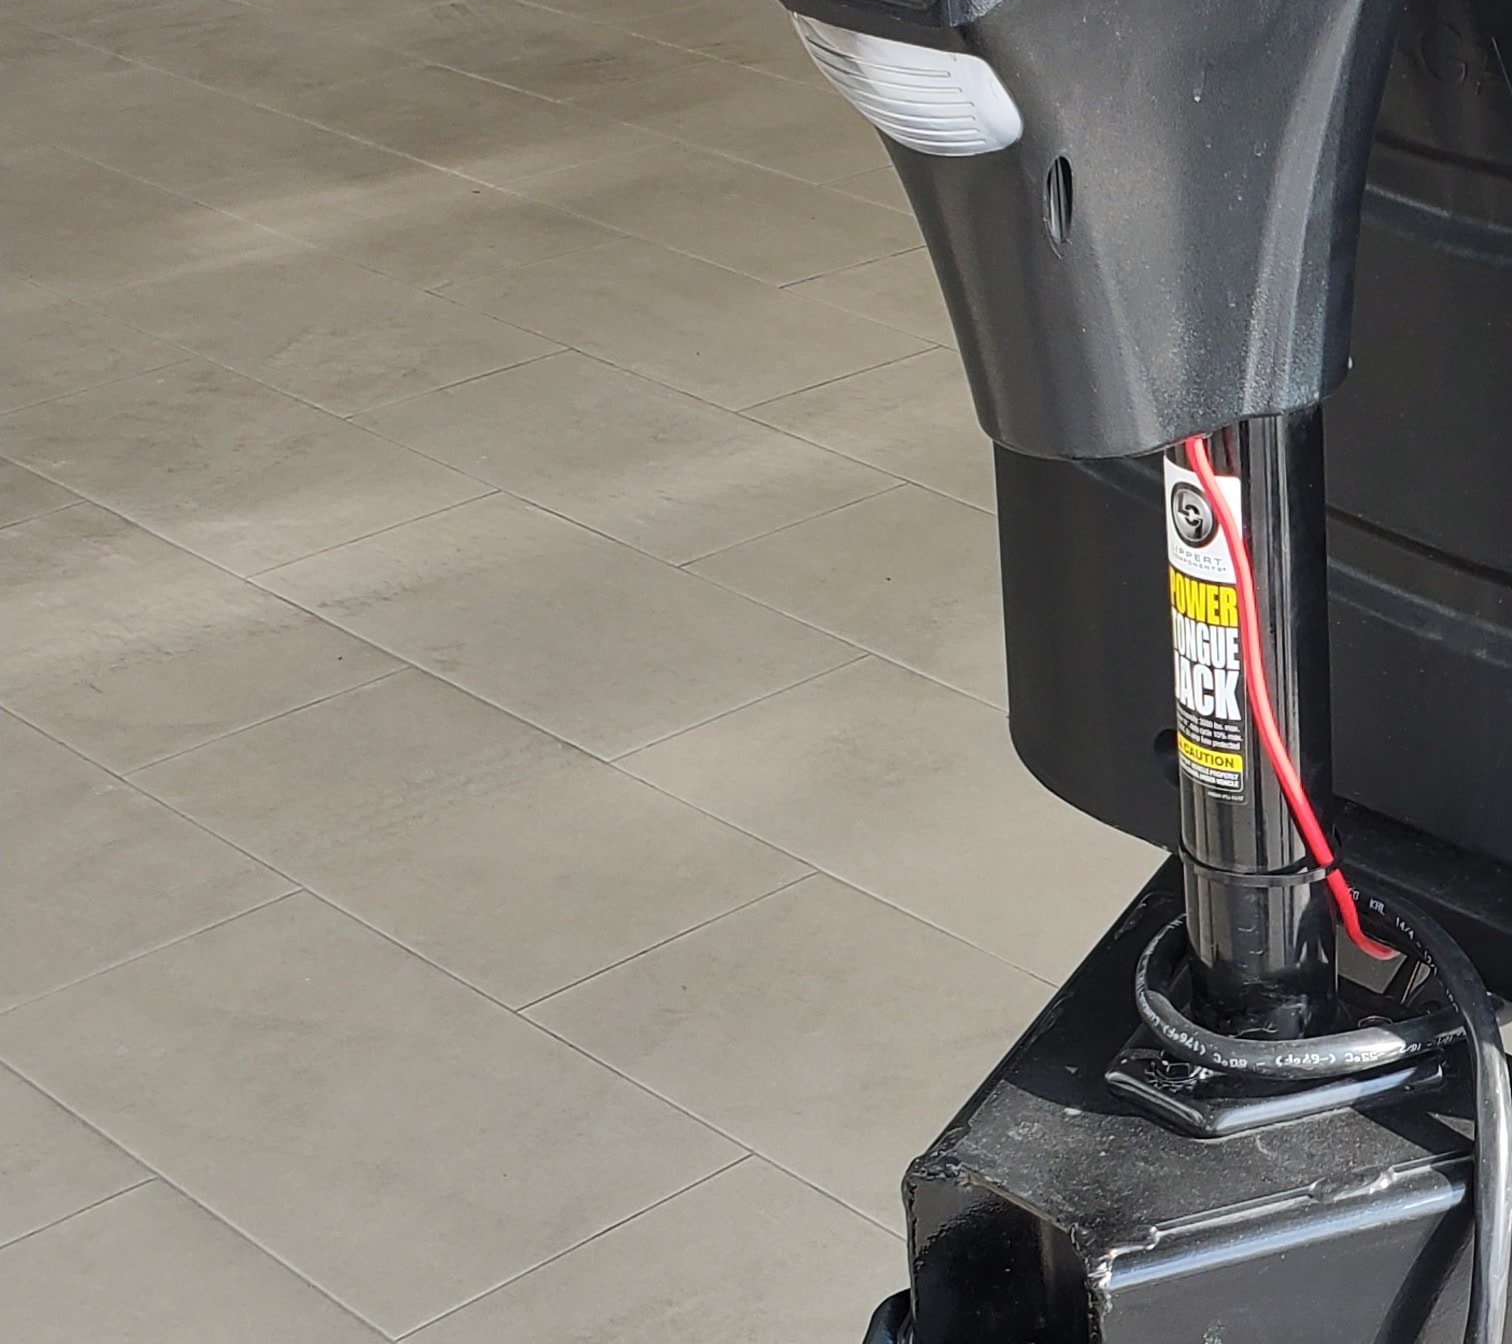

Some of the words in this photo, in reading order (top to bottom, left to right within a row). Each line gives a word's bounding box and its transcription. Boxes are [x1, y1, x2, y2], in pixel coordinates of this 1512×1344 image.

[1169, 564, 1239, 627] POWER
[1171, 606, 1240, 670] TONGUE
[1184, 743, 1235, 768] CAUTION
